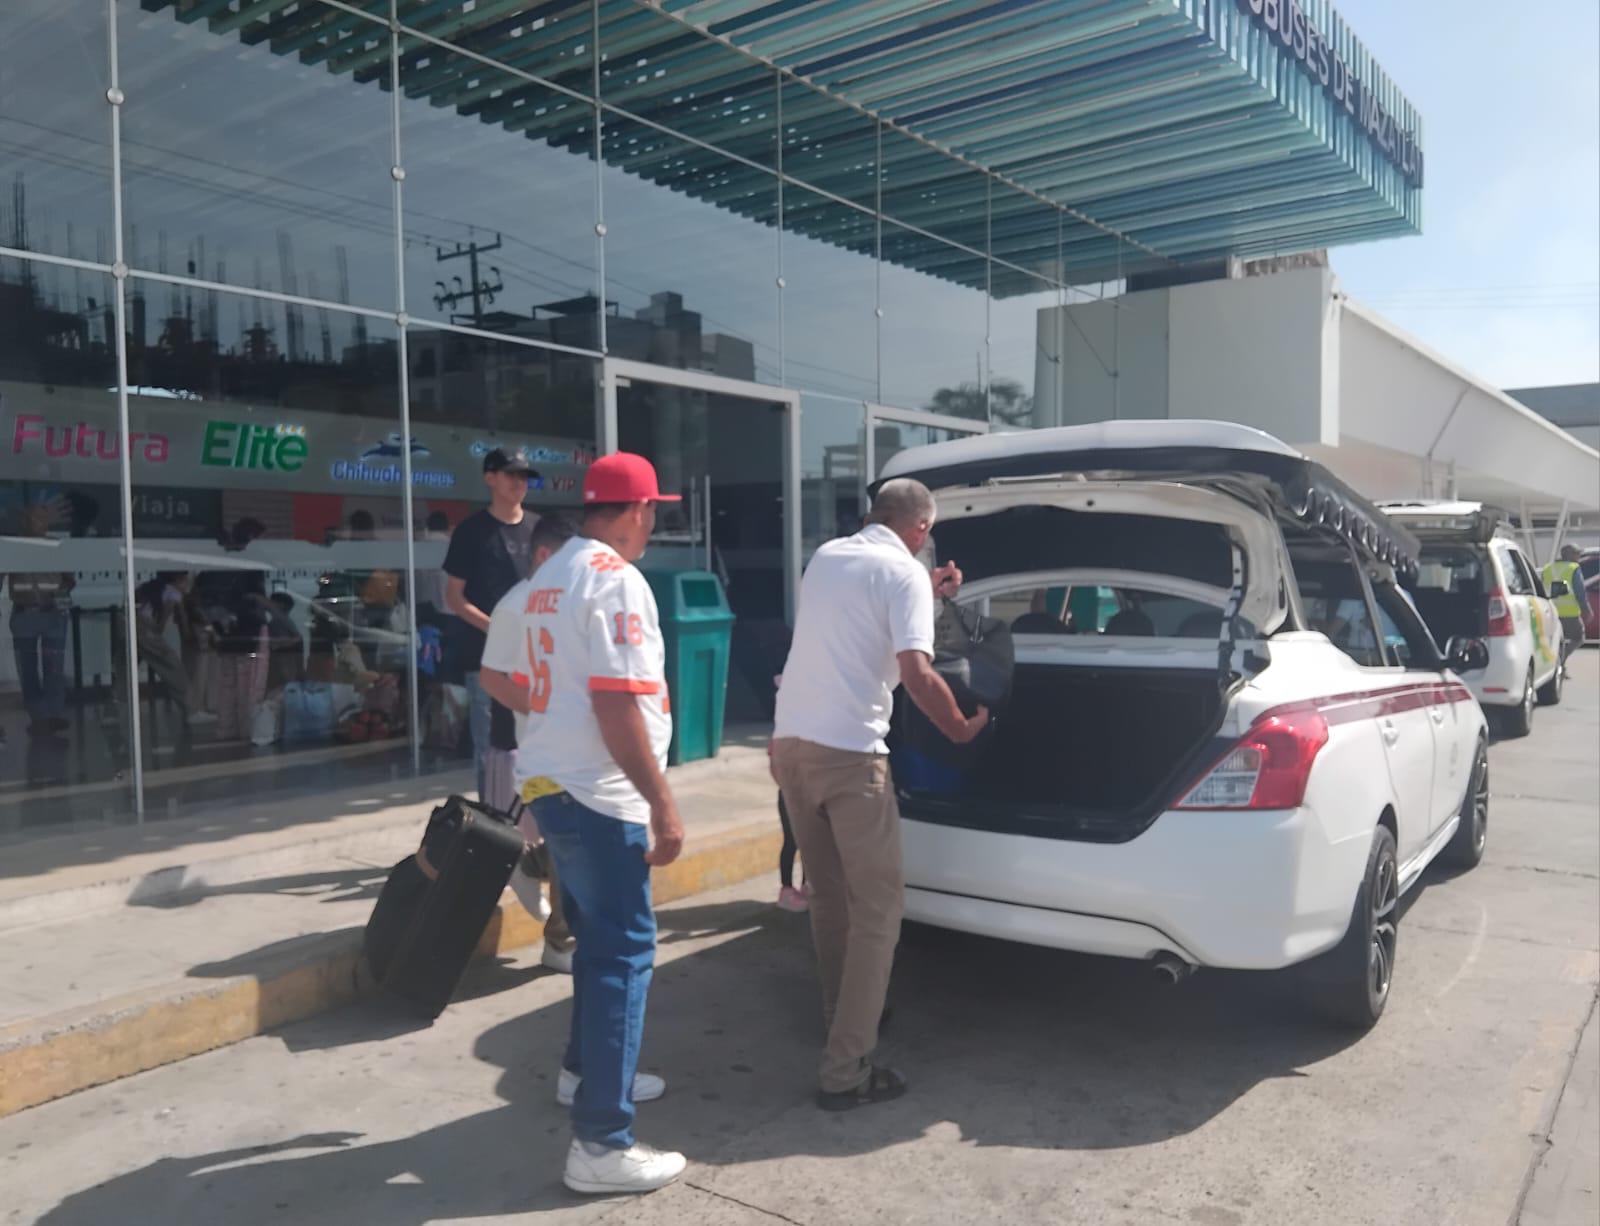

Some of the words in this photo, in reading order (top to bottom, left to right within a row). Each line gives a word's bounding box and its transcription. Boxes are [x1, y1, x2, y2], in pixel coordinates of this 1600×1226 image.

[1249, 0, 1329, 87] BUSES
[1334, 52, 1355, 115] DE
[14, 415, 170, 462] Futura
[202, 420, 308, 472] Elite
[330, 461, 455, 486] Chihuahenses
[614, 612, 643, 645] 16
